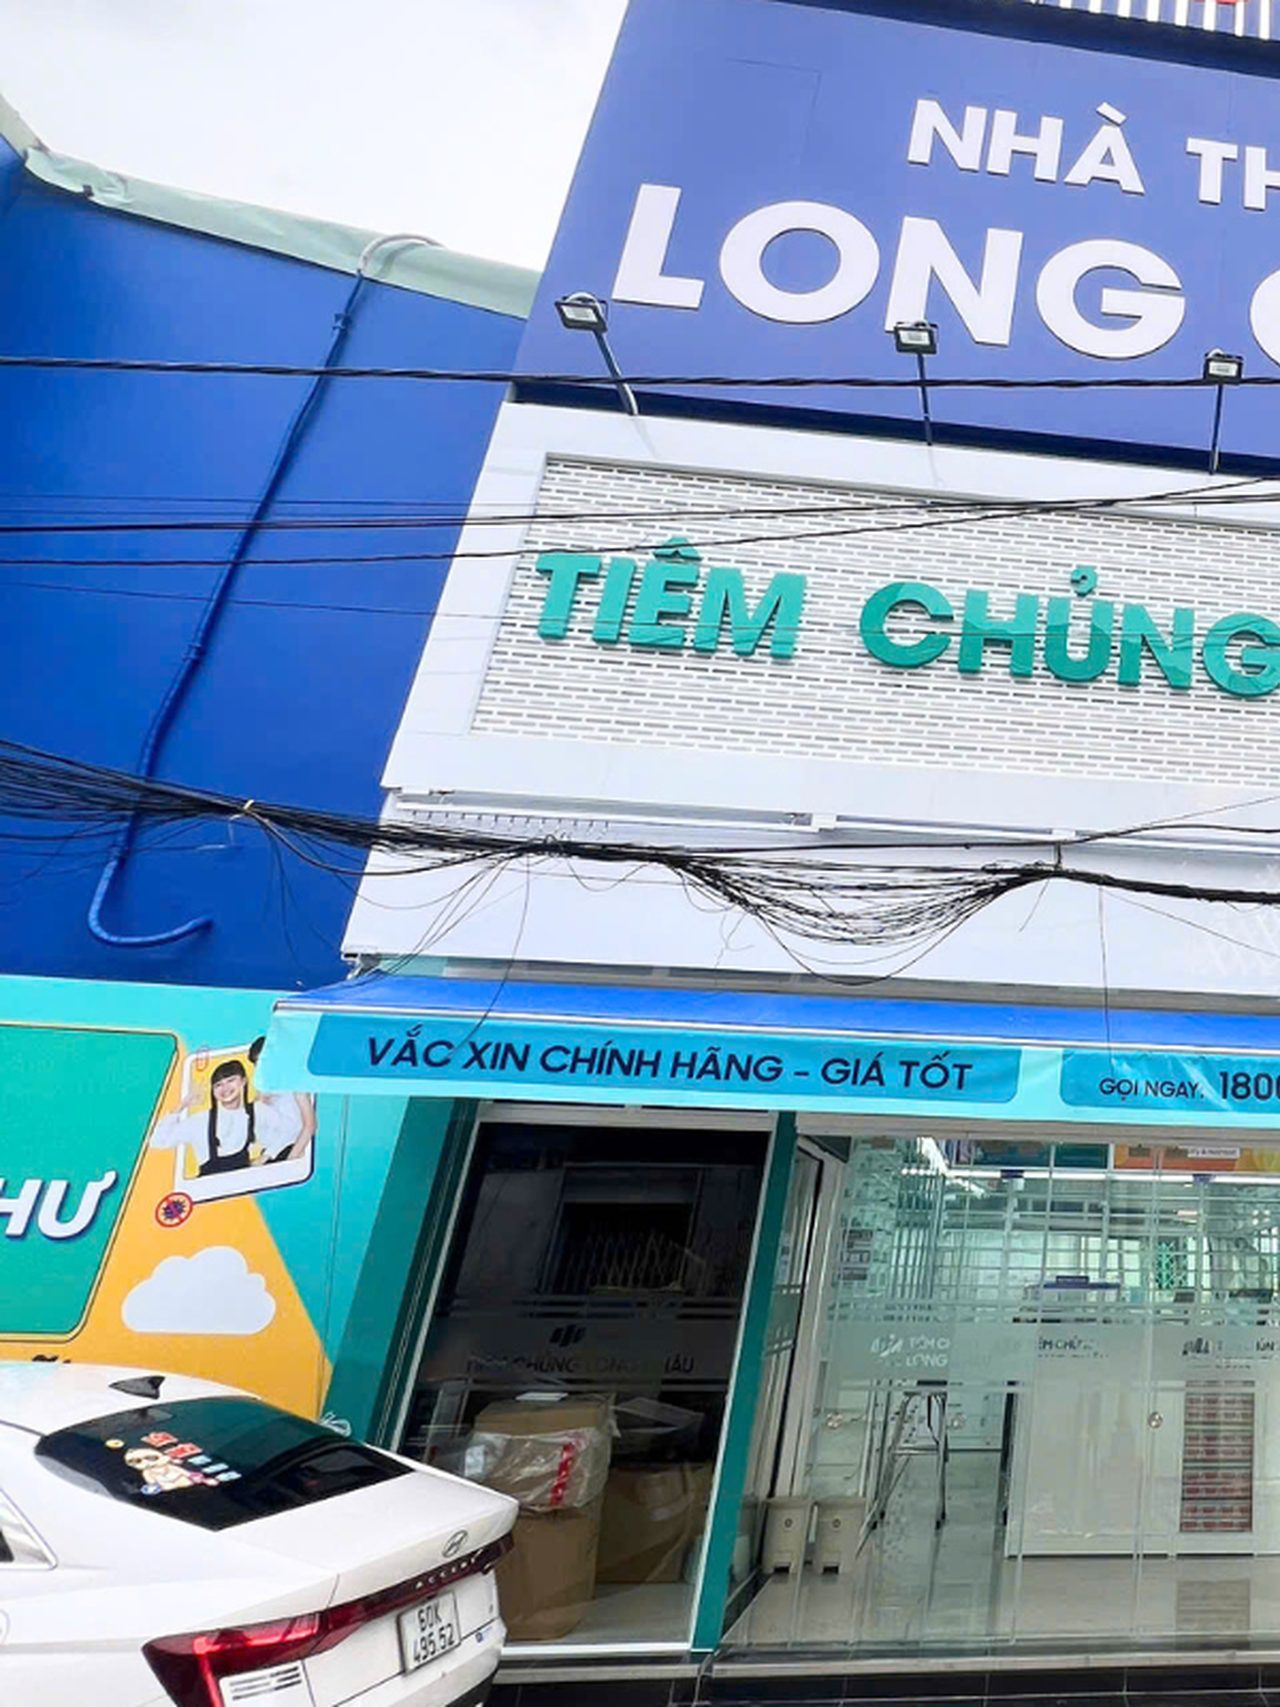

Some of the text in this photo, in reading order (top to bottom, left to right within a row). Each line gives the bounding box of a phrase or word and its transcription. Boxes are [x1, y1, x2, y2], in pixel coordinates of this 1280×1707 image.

[907, 99, 1146, 196] NHÀ
[611, 183, 1187, 360] LONG
[535, 537, 808, 660] TIÊM
[367, 1024, 455, 1068] VẮC
[461, 1040, 531, 1072] XIN
[539, 1040, 662, 1078] CHÍNH
[669, 1045, 784, 1082] HÃNG
[820, 1051, 886, 1087] GIÁ
[898, 1050, 974, 1090] TỐT
[1099, 1077, 1138, 1101] GỌI
[417, 1601, 442, 1633] 60K
